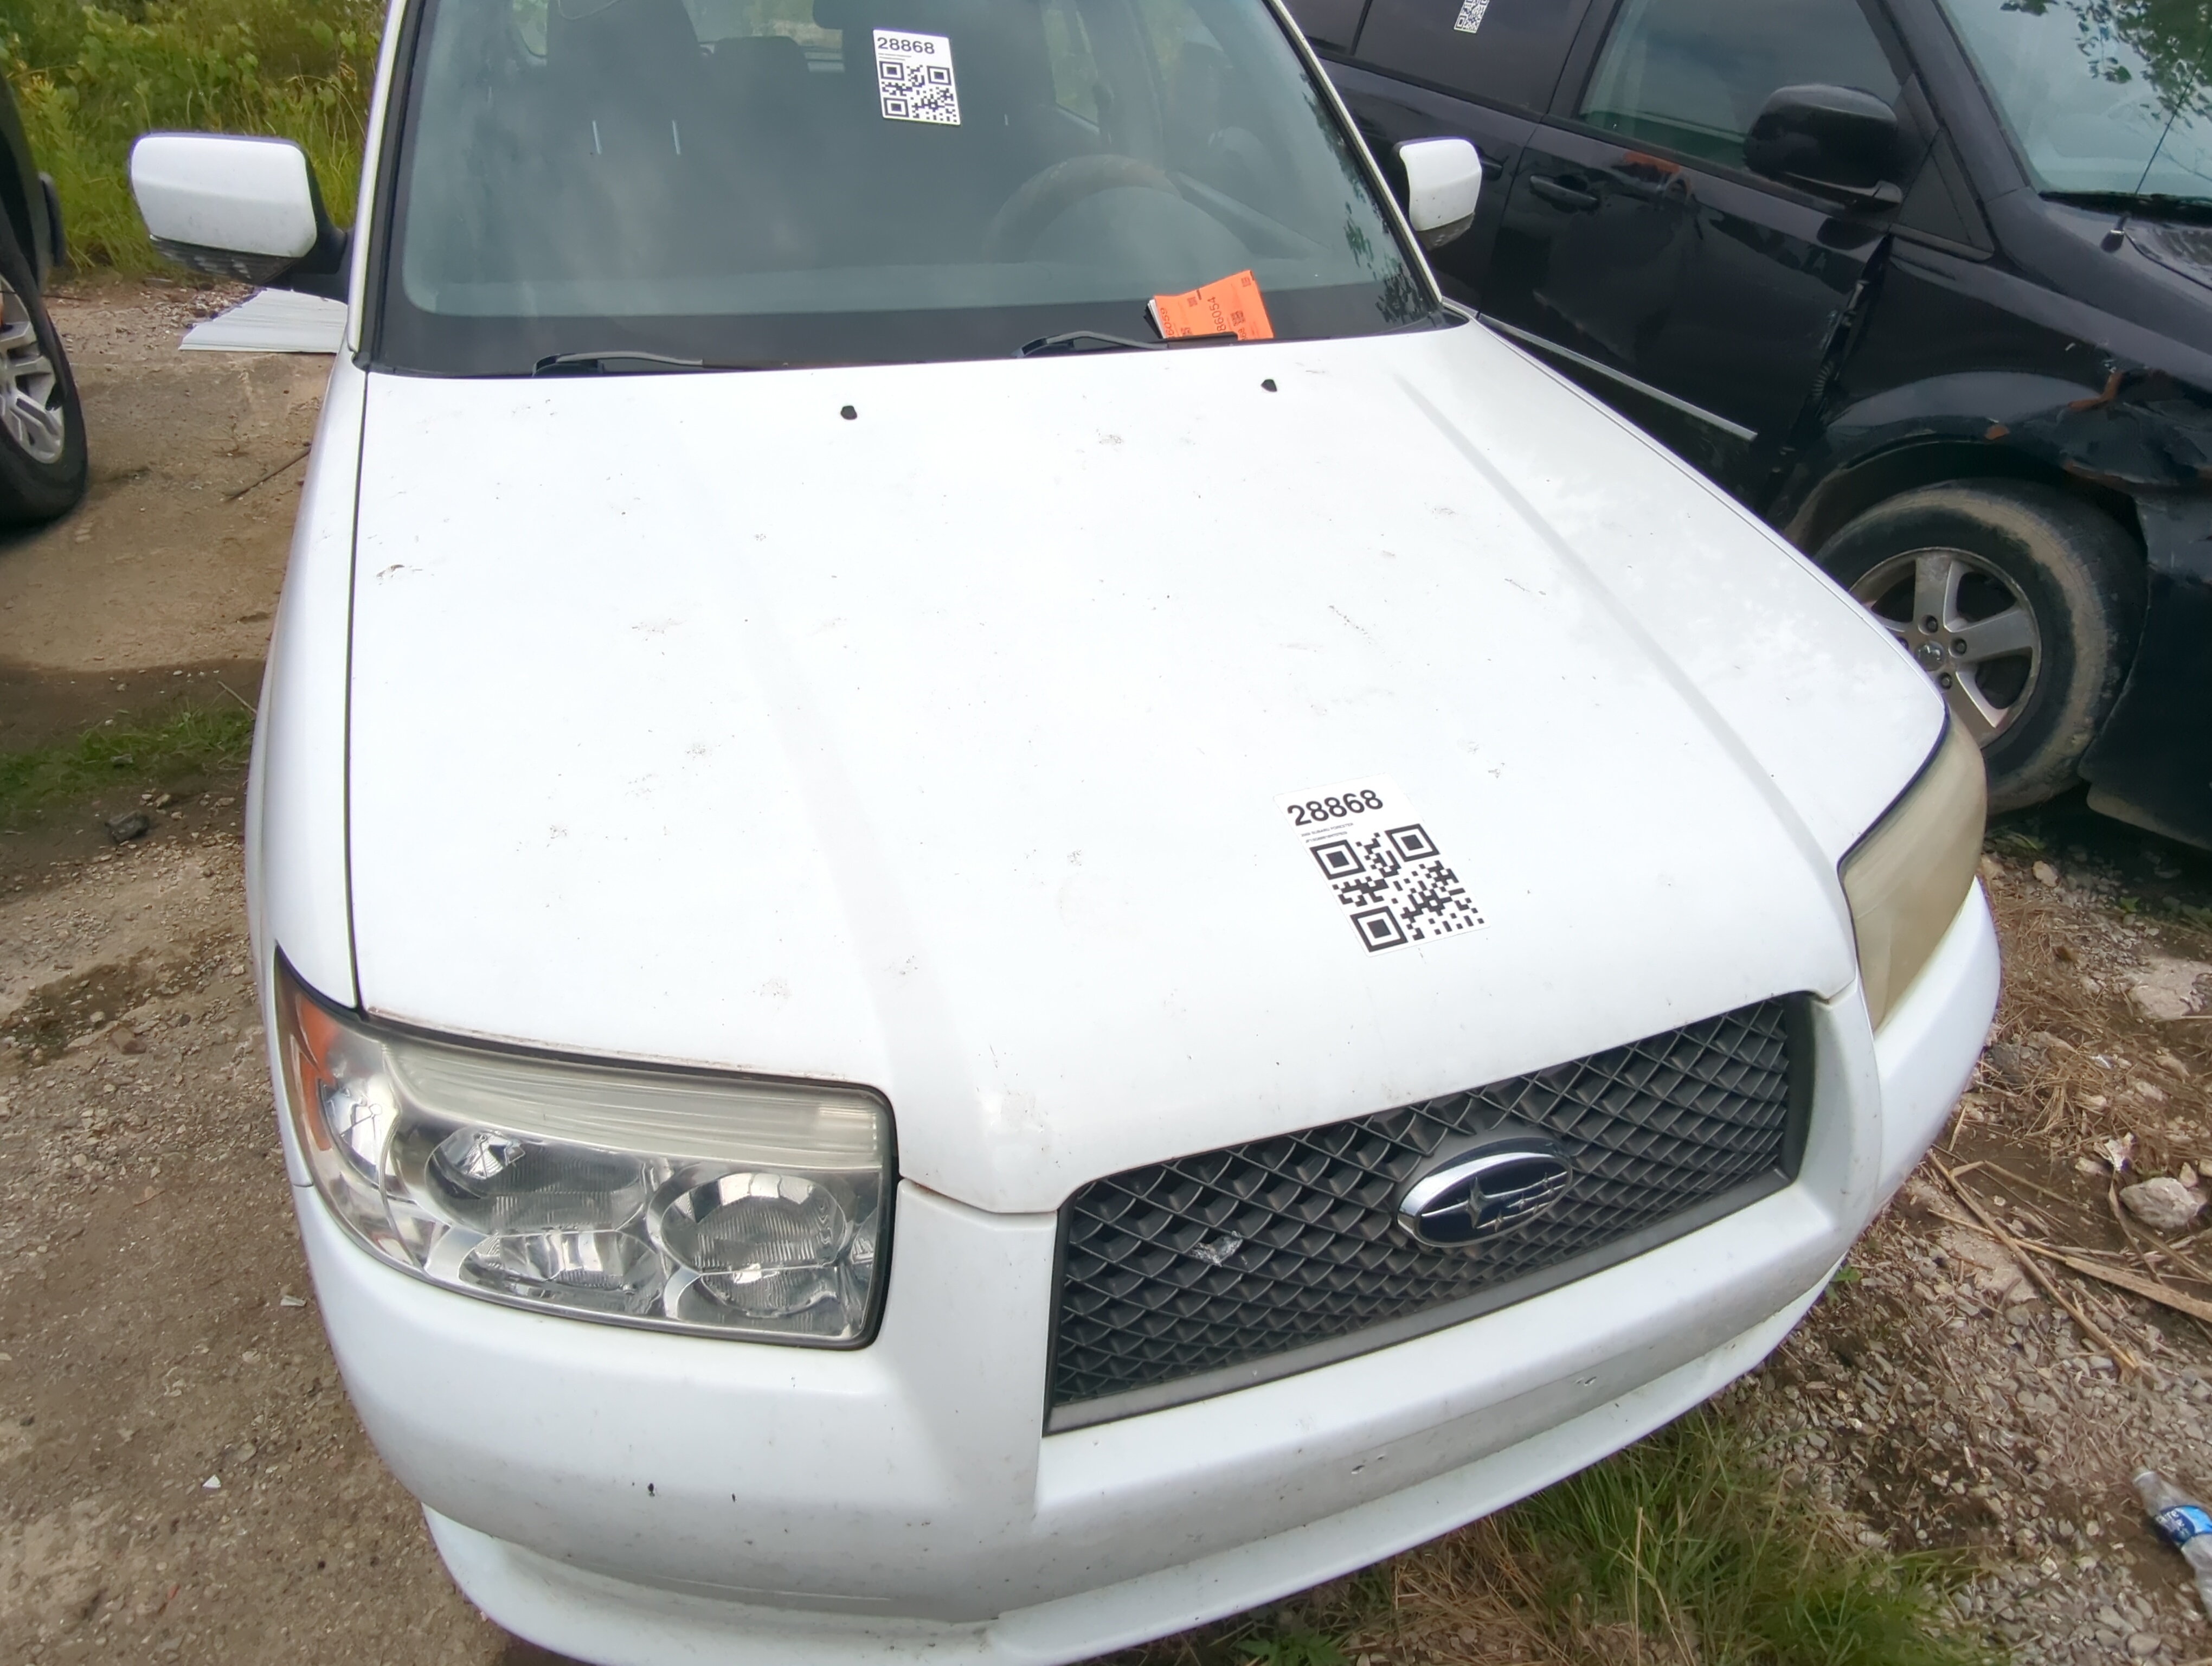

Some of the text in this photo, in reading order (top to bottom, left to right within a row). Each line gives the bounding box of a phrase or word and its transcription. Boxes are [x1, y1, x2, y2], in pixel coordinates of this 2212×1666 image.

[877, 37, 935, 54] 28868
[1160, 307, 1175, 339] 6059
[1207, 297, 1226, 331] 86054
[1287, 789, 1383, 826] 28868
